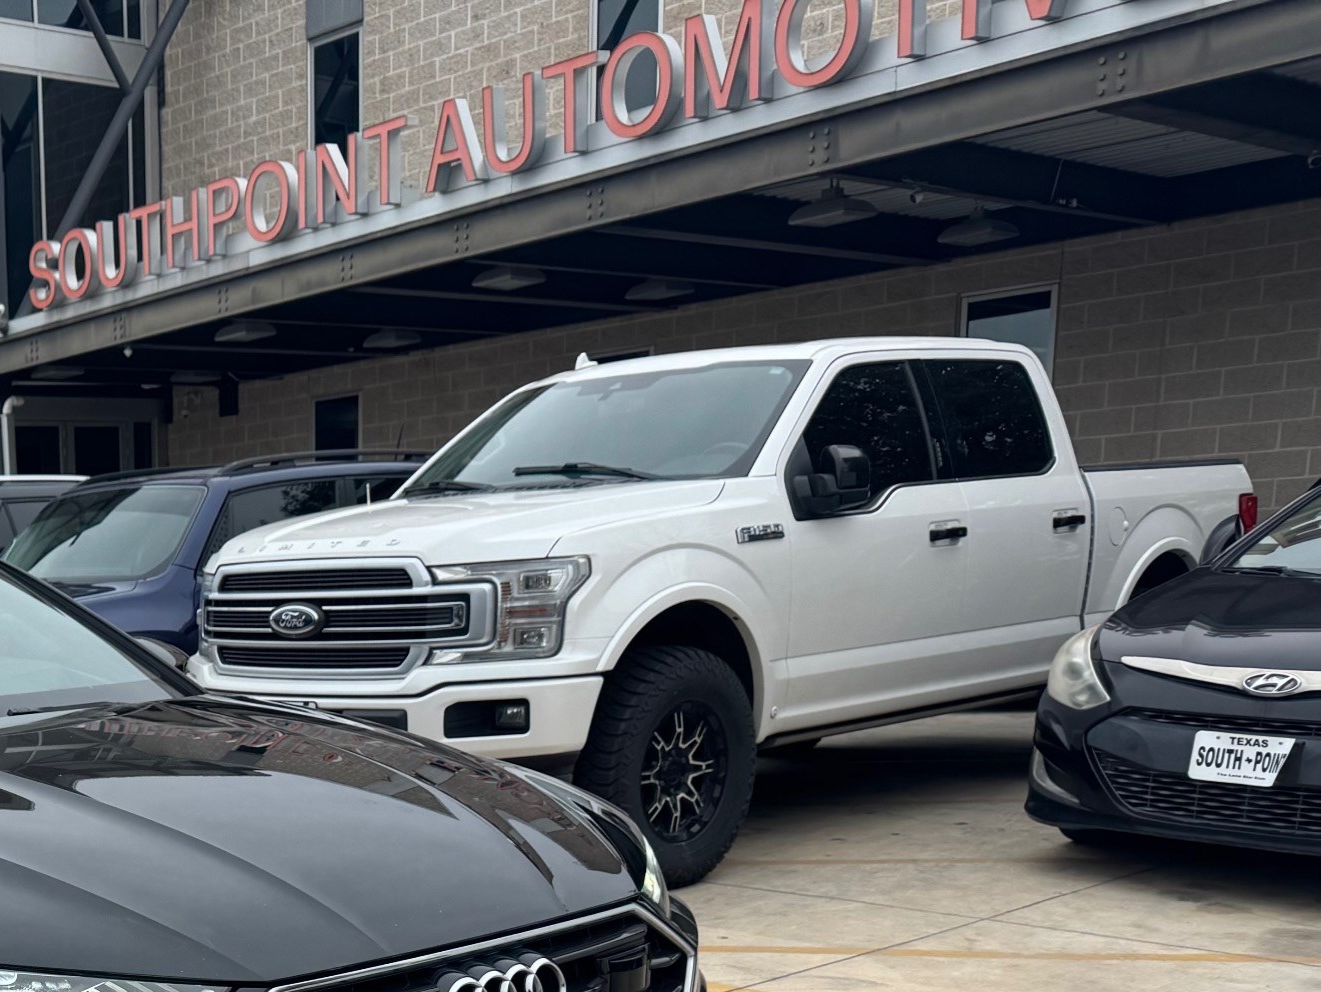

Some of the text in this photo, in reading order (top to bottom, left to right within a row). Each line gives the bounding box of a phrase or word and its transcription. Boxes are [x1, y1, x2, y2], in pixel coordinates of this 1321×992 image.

[28, 0, 1064, 310] SOUTHPOINT AUTOMO
[278, 611, 306, 628] Ford
[1229, 736, 1269, 748] TEXAS
[1196, 746, 1244, 770] SOUTH
